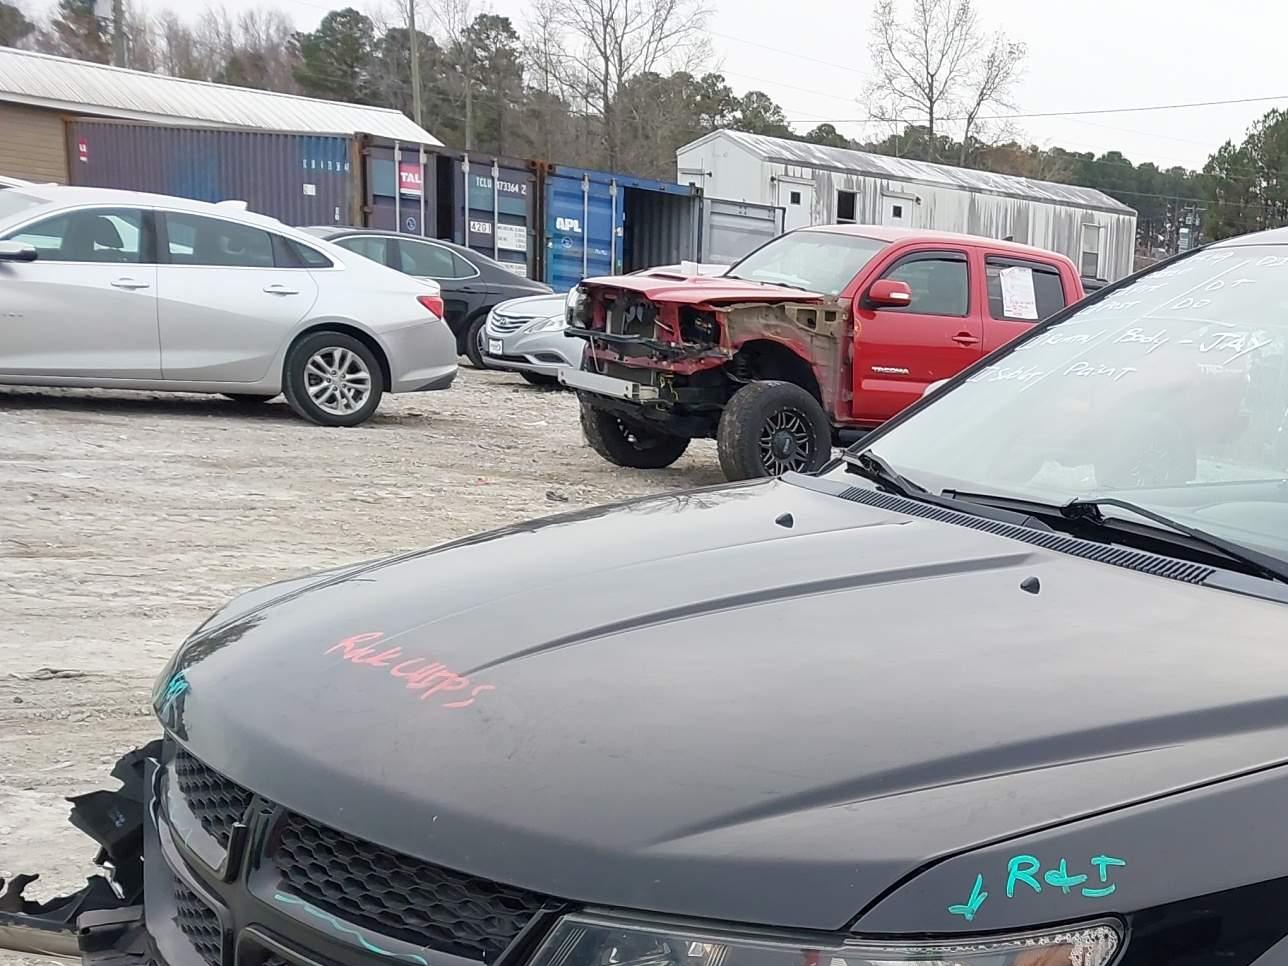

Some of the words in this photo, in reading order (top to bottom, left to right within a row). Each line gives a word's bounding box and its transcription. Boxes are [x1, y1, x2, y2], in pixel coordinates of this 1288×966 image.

[400, 172, 422, 183] TAL
[556, 217, 582, 233] APL
[871, 366, 910, 376] TACOMA
